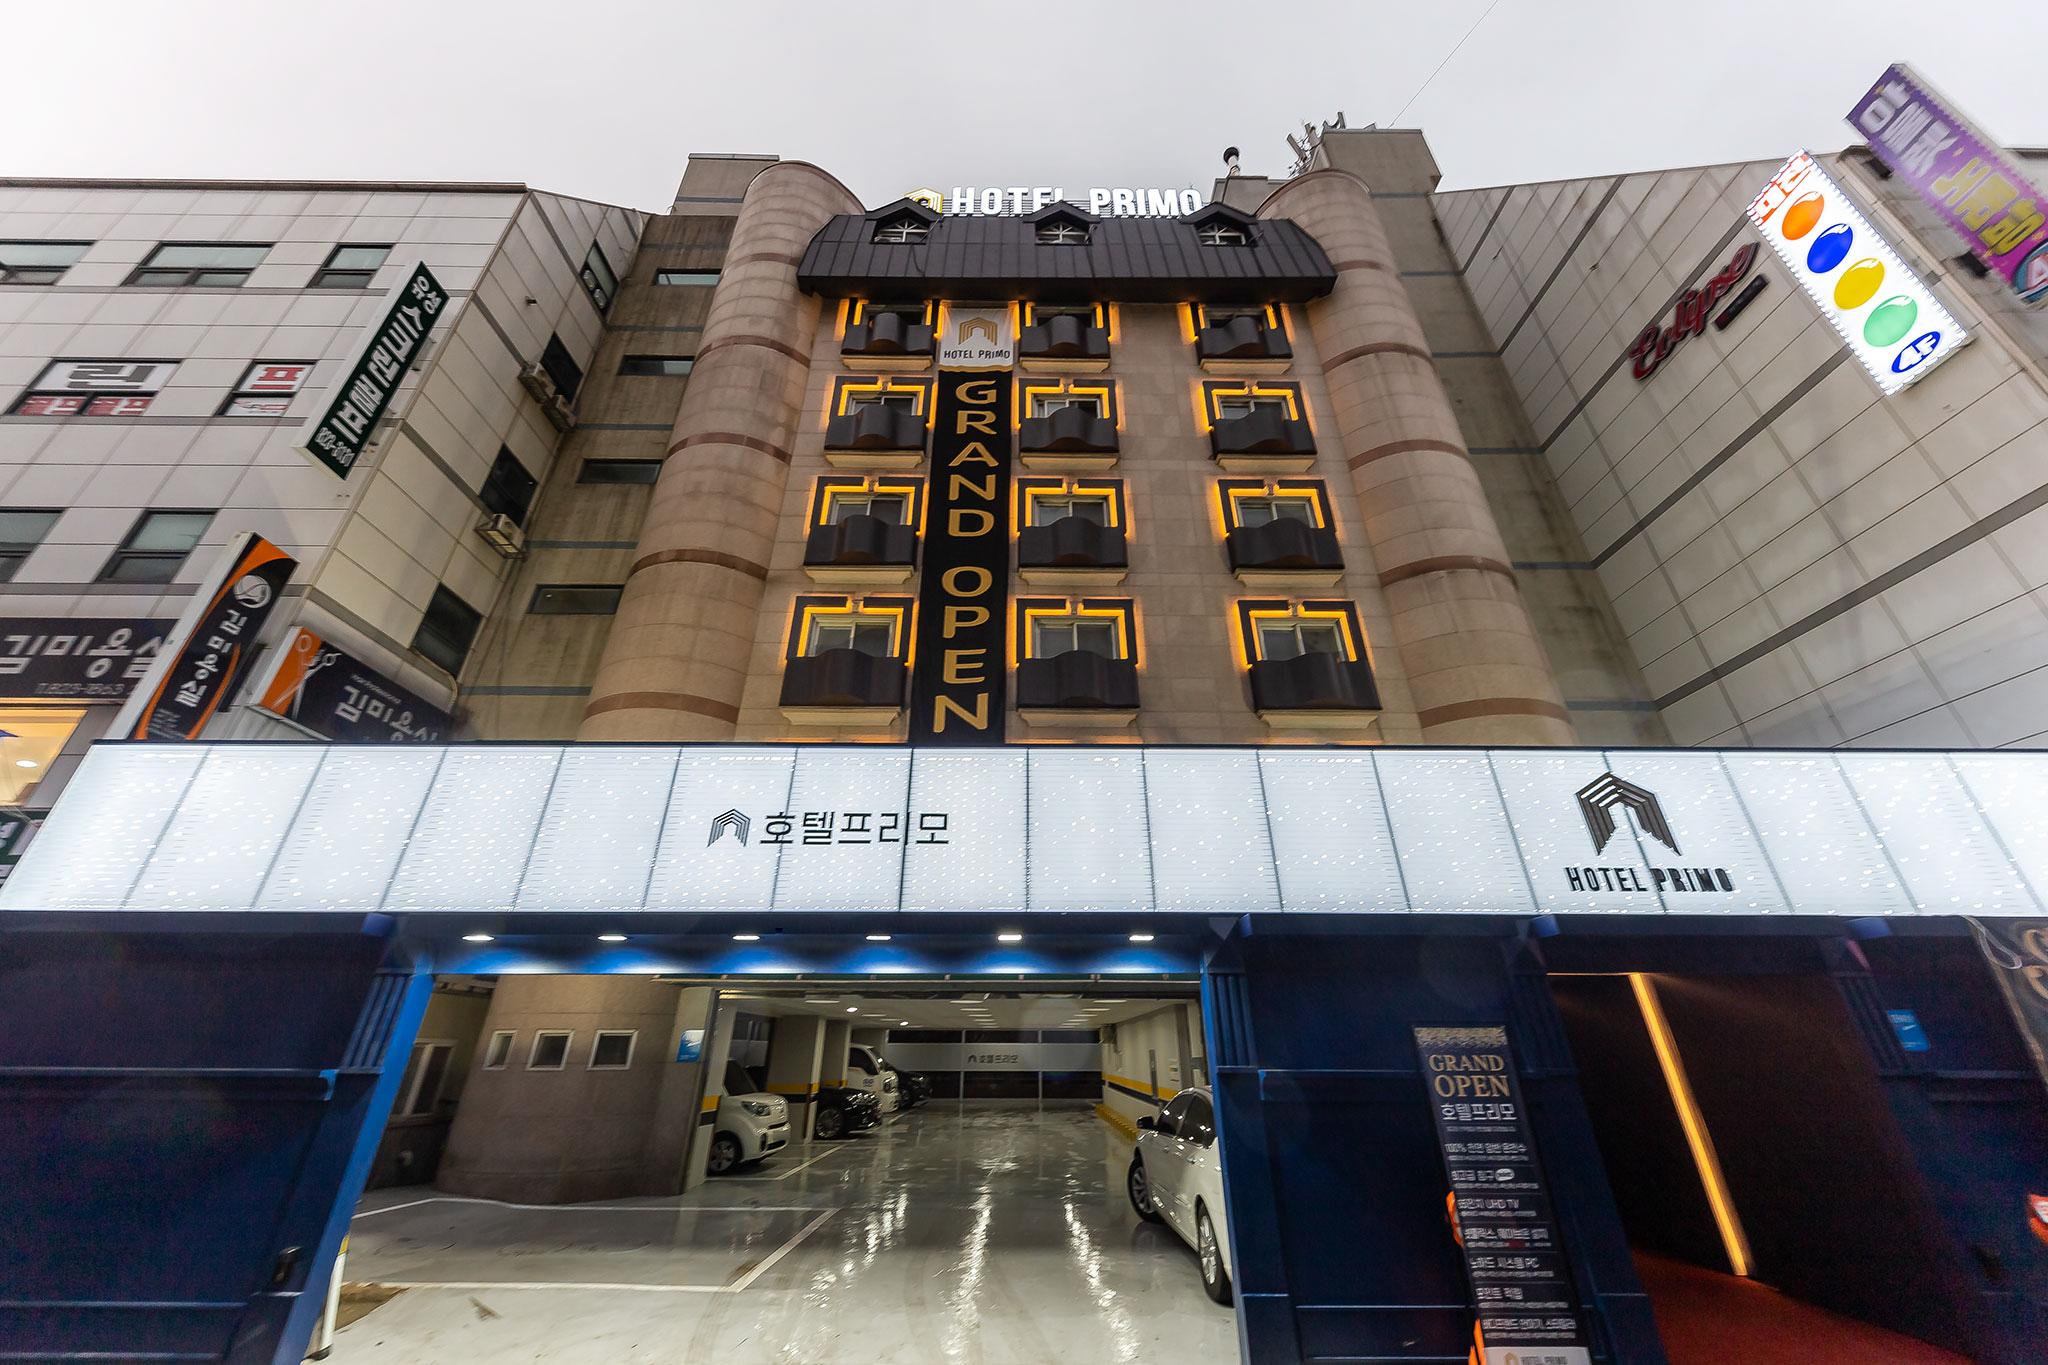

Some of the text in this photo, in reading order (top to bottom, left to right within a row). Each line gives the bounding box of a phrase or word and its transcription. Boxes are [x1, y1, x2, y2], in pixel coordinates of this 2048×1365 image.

[1089, 187, 1202, 217] PRIMO
[943, 349, 1011, 359] HOTEL PRIMO
[1895, 333, 1938, 372] 4F
[948, 380, 1000, 537] GRAND
[174, 609, 248, 708] 김미용실
[932, 565, 993, 733] OPEN
[759, 811, 950, 845] 호텔프리모
[1564, 867, 1735, 892] HOTEL PRIMO
[1428, 1054, 1505, 1072] GRAND
[1433, 1074, 1511, 1098] OPEN
[1440, 1103, 1517, 1121] 호텔프리모
